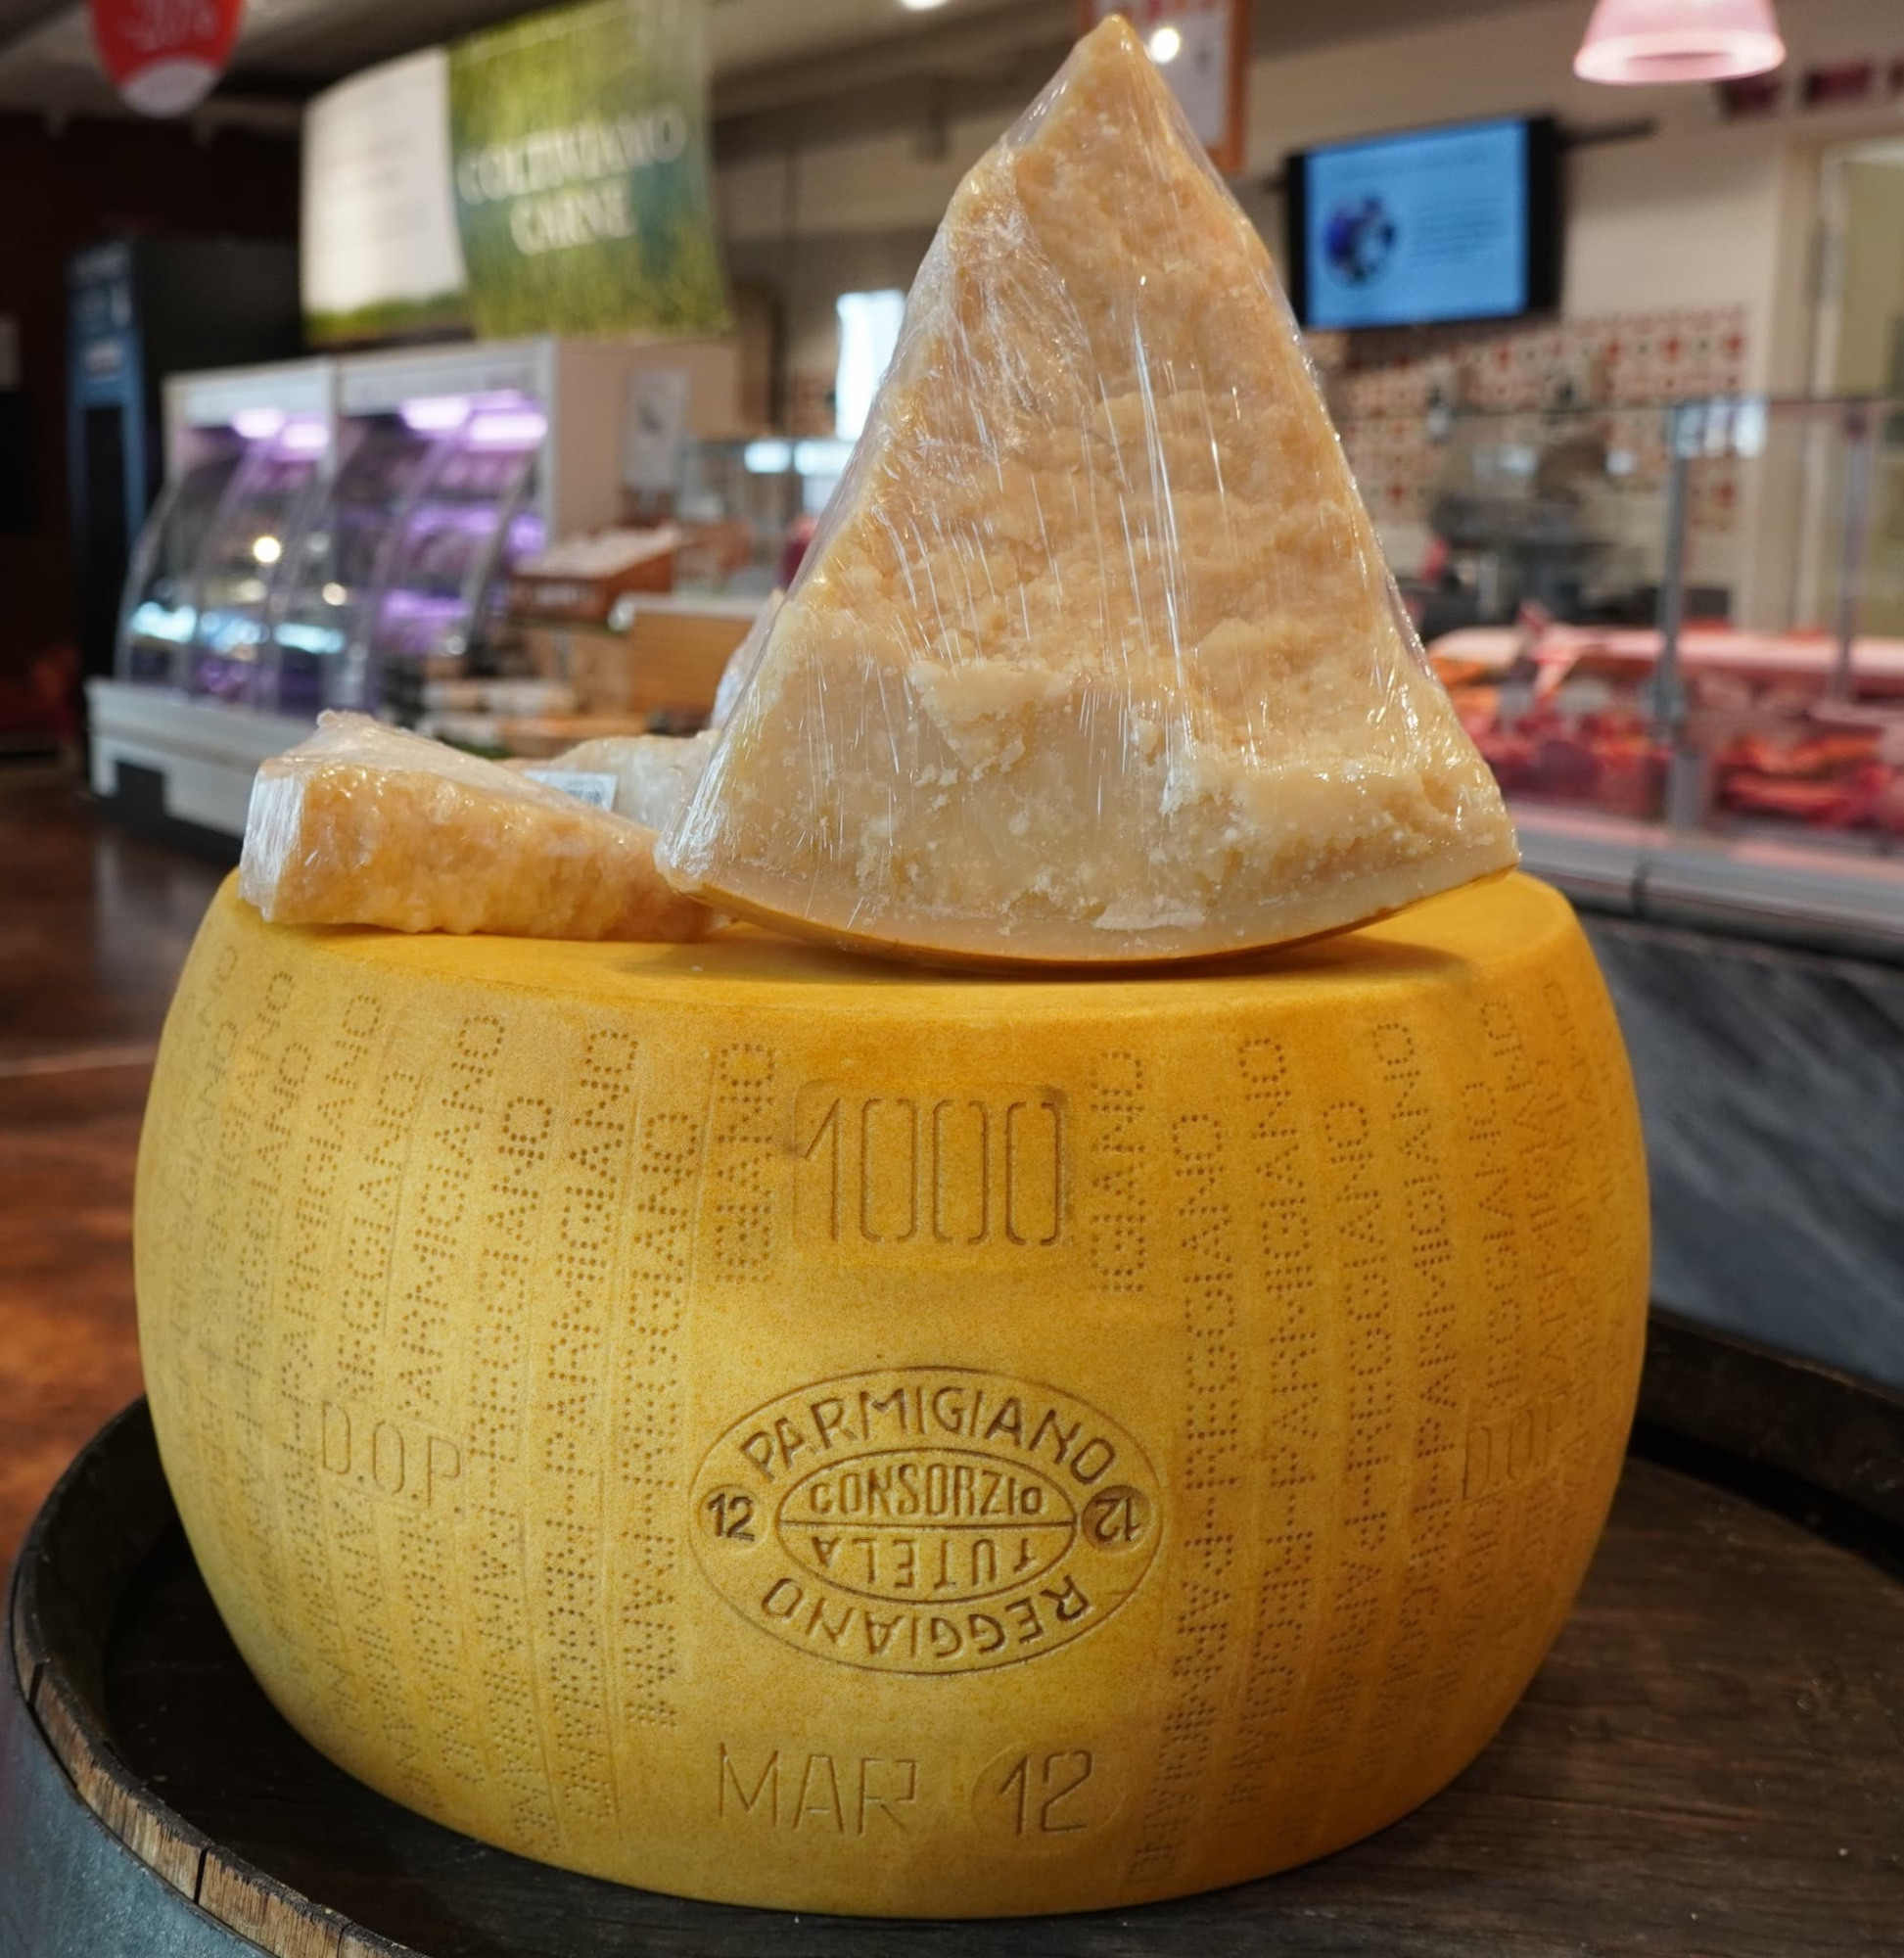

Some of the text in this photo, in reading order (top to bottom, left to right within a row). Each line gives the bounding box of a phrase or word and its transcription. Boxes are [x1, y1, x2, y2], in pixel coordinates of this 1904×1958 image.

[803, 1097, 1061, 1246] 1000
[739, 1385, 1117, 1485] PARMIGIANO
[707, 1491, 756, 1542] 12
[809, 1463, 1044, 1517] CONSORZIO
[1092, 1495, 1140, 1542] 12
[810, 1535, 1039, 1590] TUTELA
[760, 1575, 1091, 1657] REGGIANO
[720, 1742, 917, 1836] MAR
[998, 1749, 1093, 1837] 12
